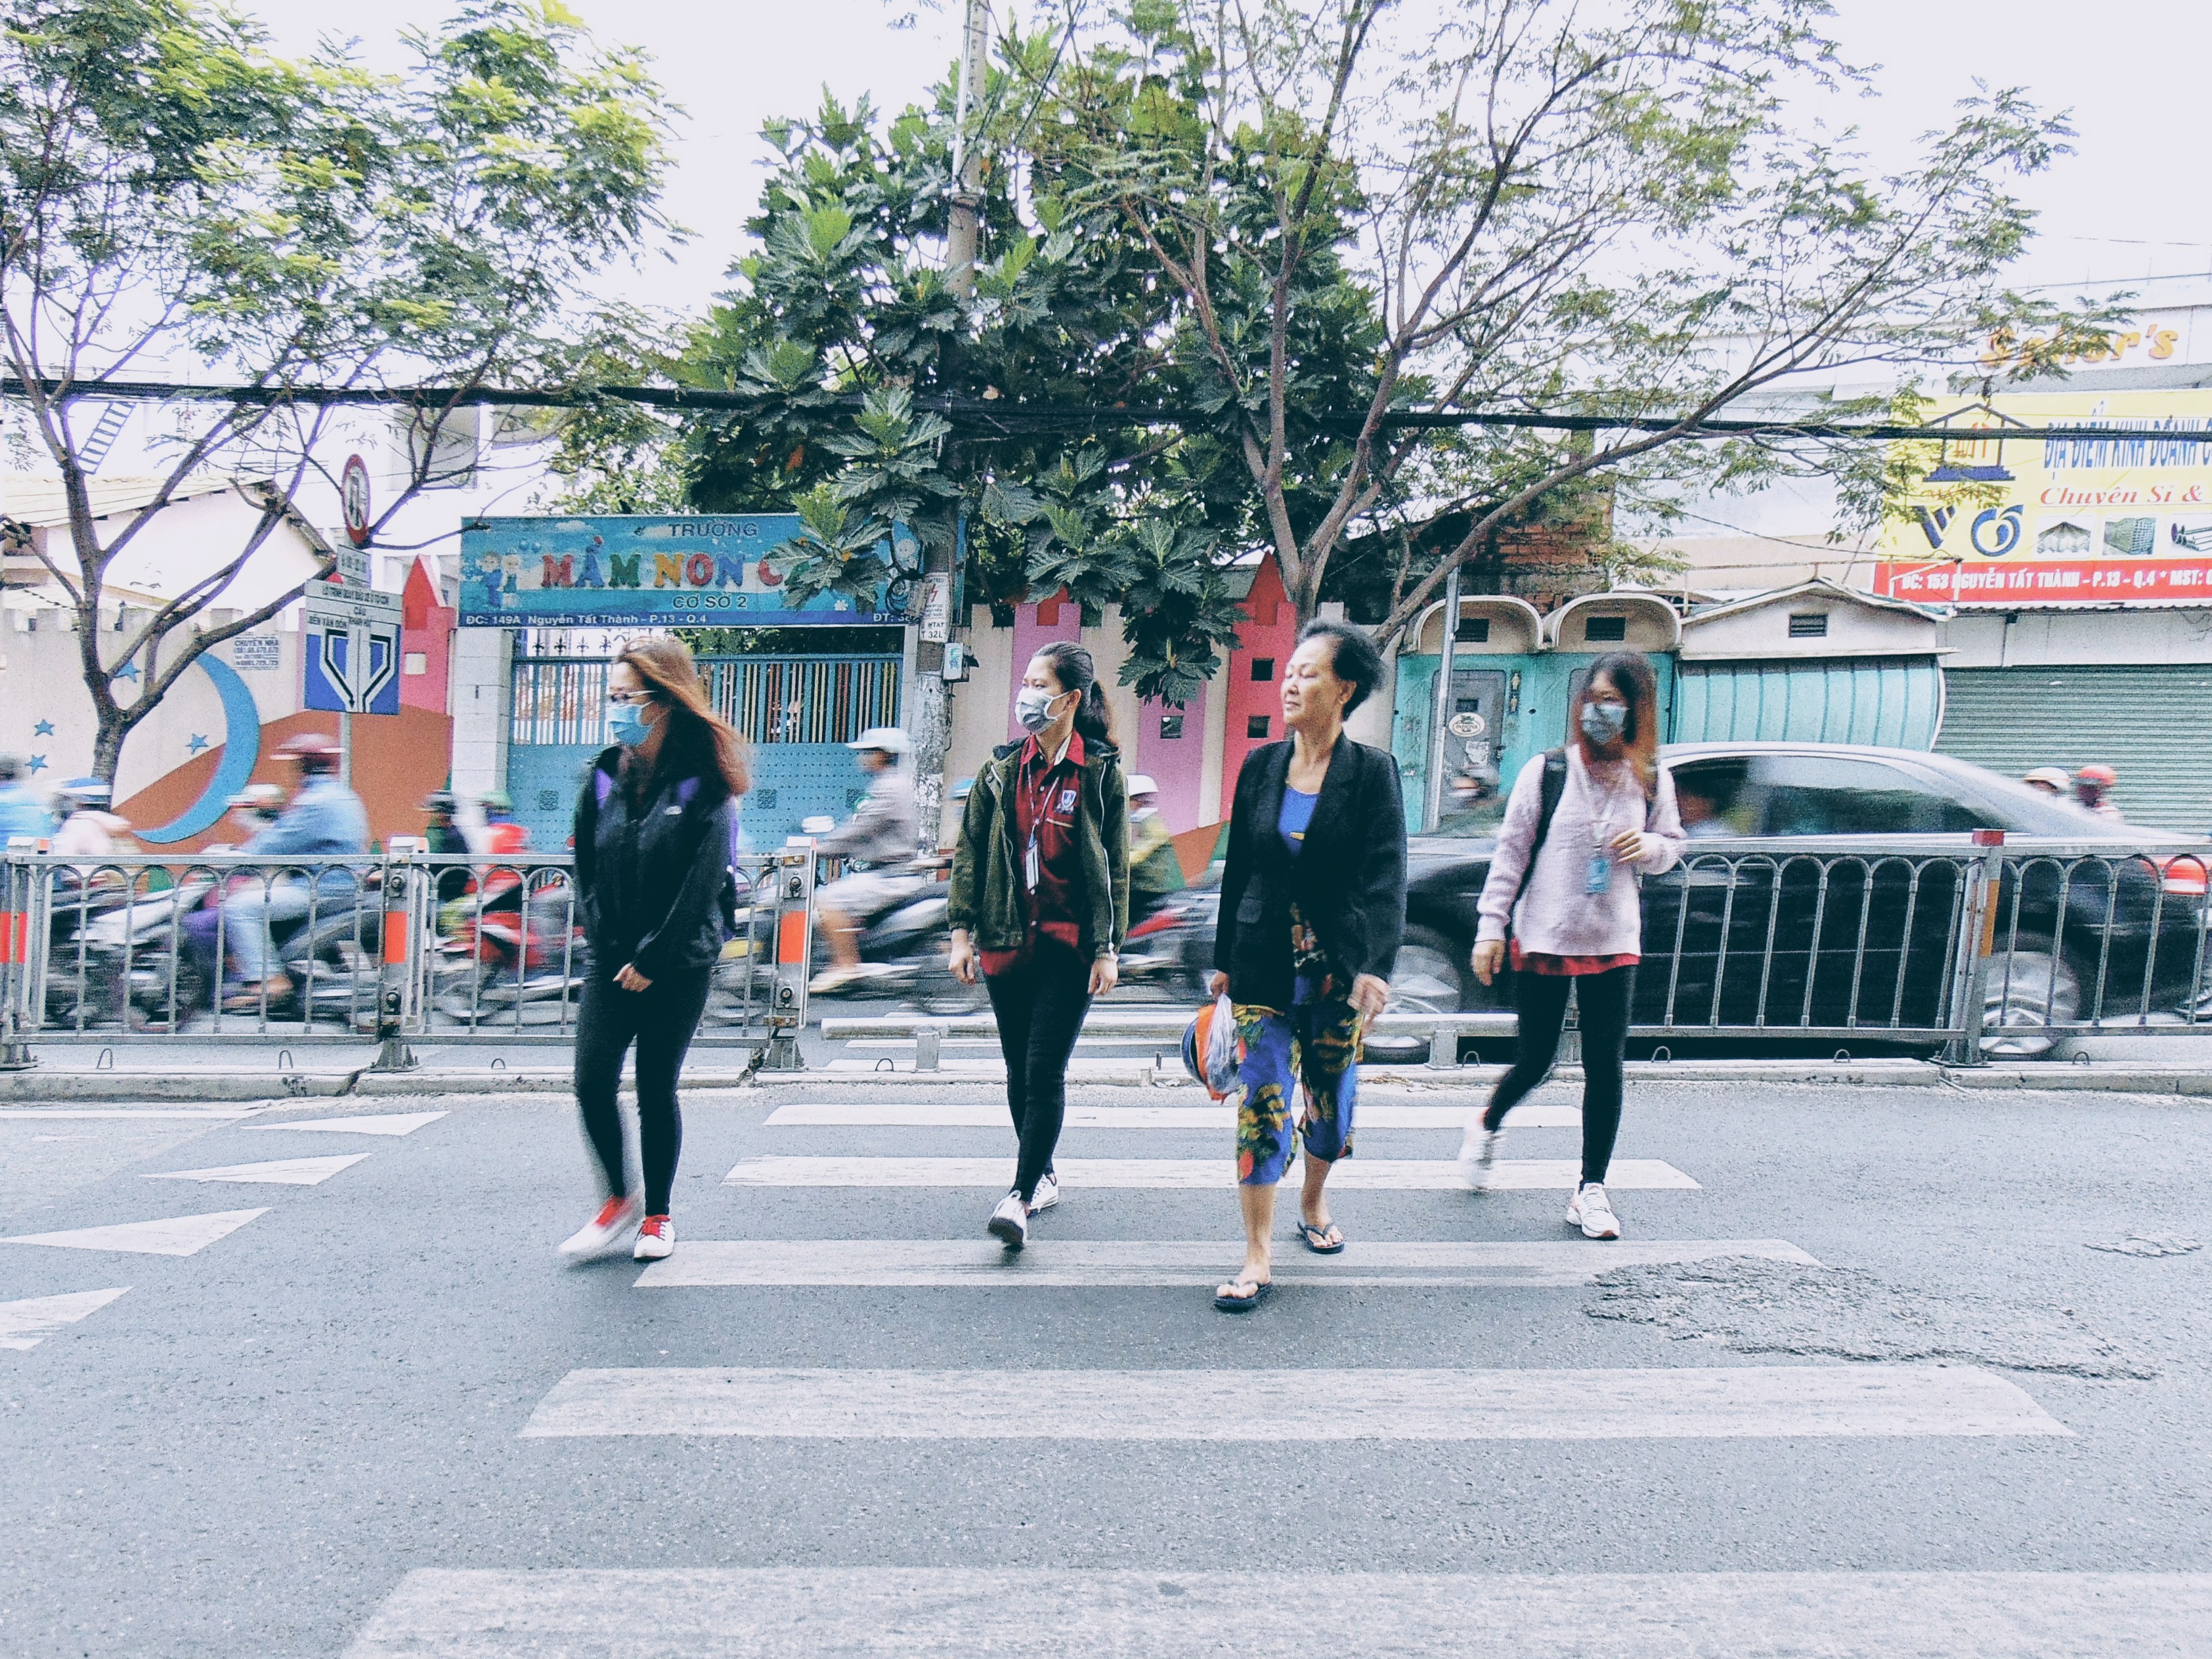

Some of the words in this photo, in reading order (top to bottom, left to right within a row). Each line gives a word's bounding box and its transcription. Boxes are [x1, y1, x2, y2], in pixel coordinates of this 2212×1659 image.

[2182, 485, 2203, 502] &
[653, 553, 747, 589] NON
[1927, 573, 1949, 589] 153
[2008, 567, 2034, 588] TẤT
[2037, 569, 2080, 588] THÀNH
[2092, 571, 2121, 588] P.13
[2133, 571, 2156, 589] Q.4
[2169, 569, 2203, 586] MST:
[672, 593, 700, 609] CƠ
[737, 595, 747, 609] 2
[466, 614, 488, 625] ĐC:
[492, 614, 521, 625] 149A
[577, 613, 596, 624] Tất
[601, 614, 638, 624] Thành
[649, 614, 676, 624] P.13
[686, 614, 707, 624] Q.4
